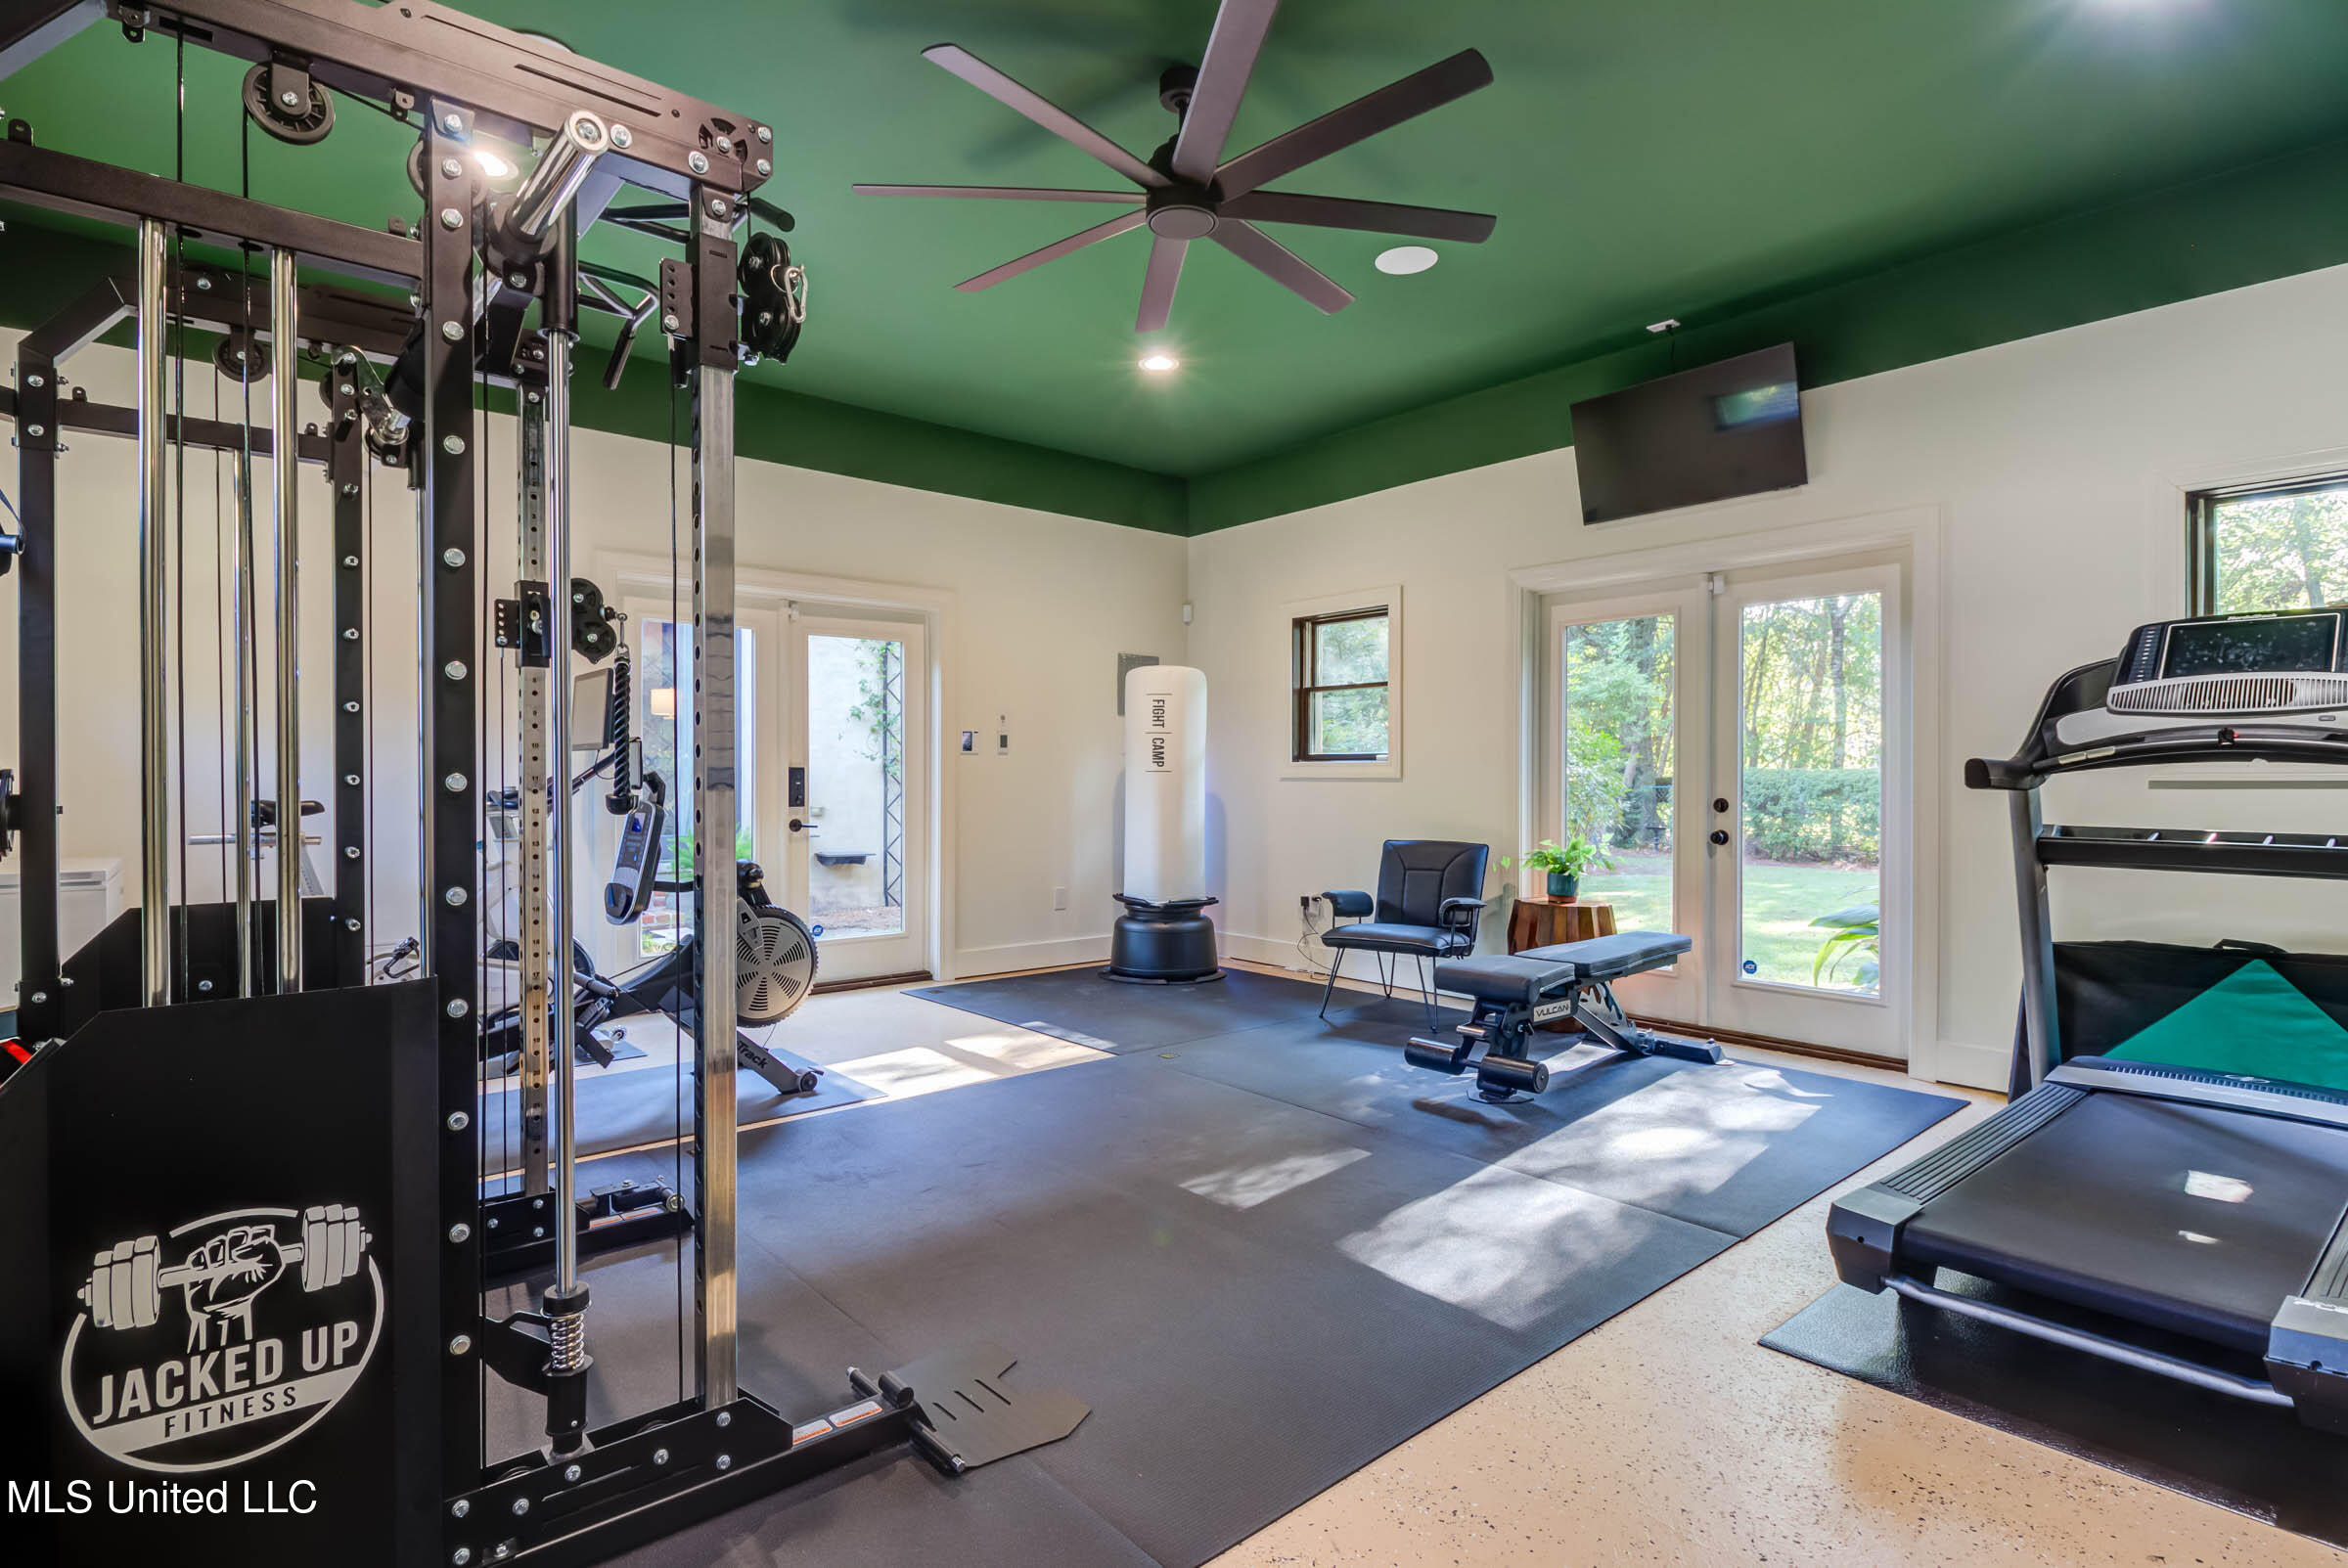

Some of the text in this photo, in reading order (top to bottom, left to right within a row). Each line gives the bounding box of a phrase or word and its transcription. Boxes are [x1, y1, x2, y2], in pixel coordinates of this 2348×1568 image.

[1151, 698, 1165, 768] FIGHT CAMP
[1535, 1004, 1569, 1017] VULCAN
[93, 1321, 359, 1425] JACKED UP
[163, 1386, 297, 1438] FITNESS
